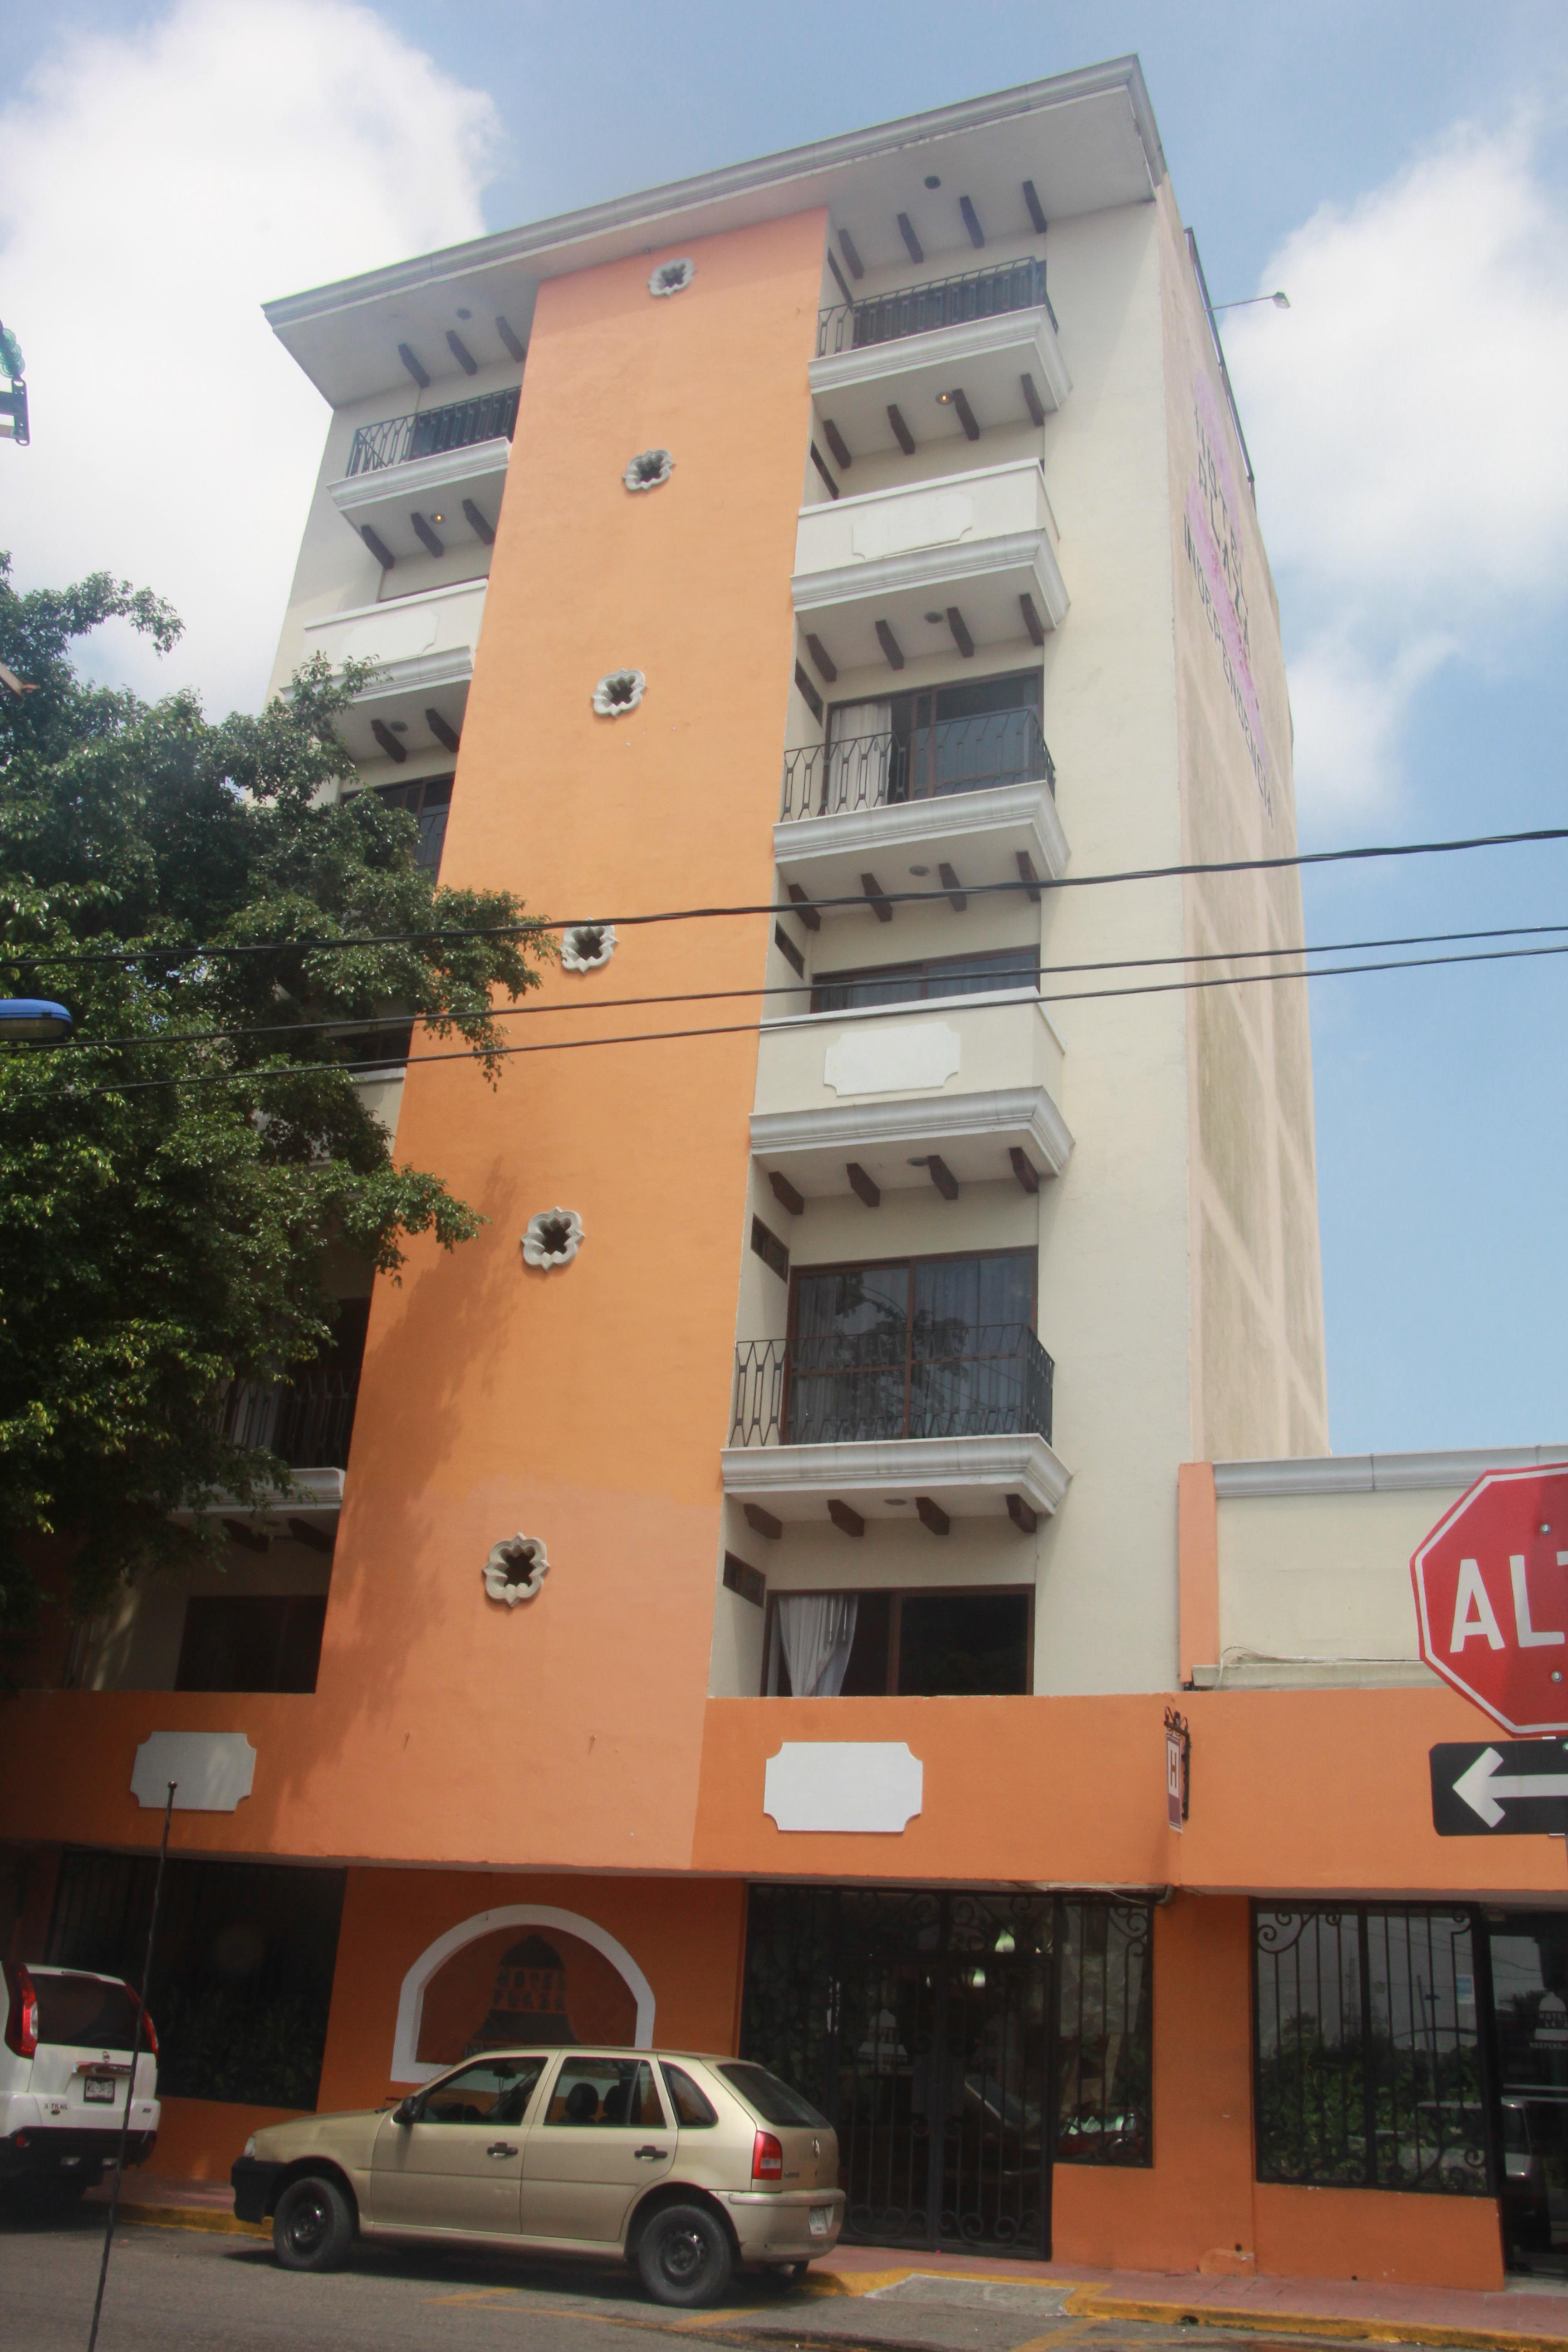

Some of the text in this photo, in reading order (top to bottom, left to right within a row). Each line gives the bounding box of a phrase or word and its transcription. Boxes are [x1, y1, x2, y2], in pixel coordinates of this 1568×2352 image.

[1195, 405, 1249, 617] HOTEL
[1198, 452, 1250, 660] PLAZA
[1183, 512, 1274, 829] INDEPENDENCIA
